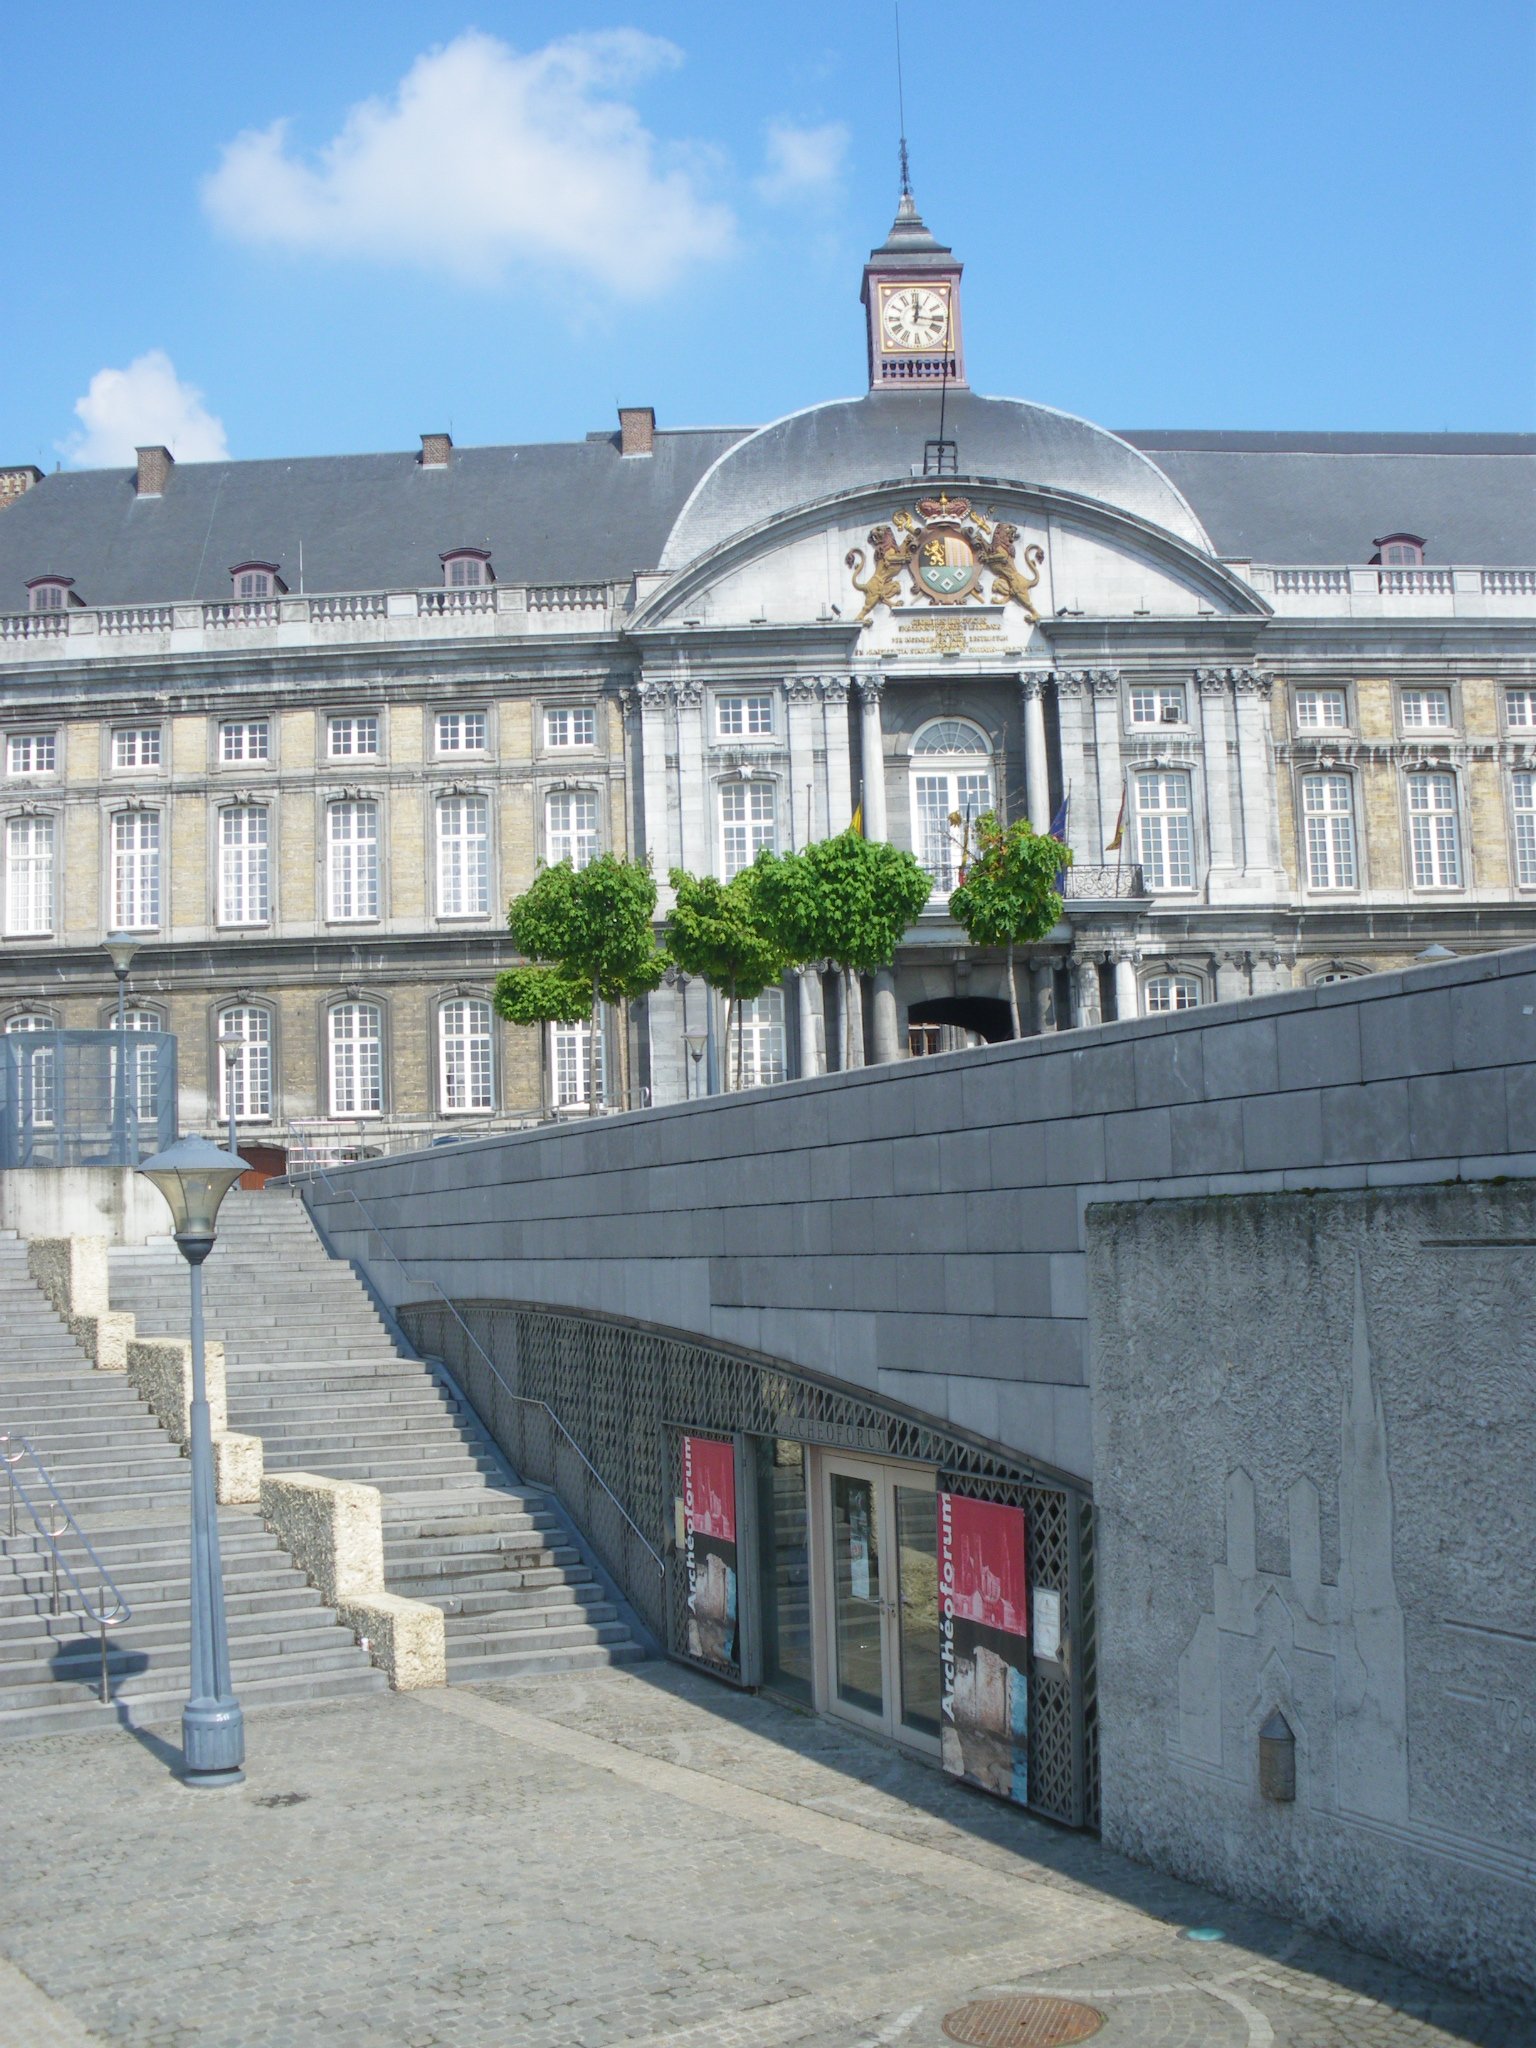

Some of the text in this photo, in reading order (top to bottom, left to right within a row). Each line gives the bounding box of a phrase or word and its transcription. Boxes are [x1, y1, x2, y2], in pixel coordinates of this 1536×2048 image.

[780, 1417, 886, 1450] RCHEOFORUM
[684, 1436, 697, 1615] Archéoforum
[939, 1494, 955, 1722] Archéoforum
